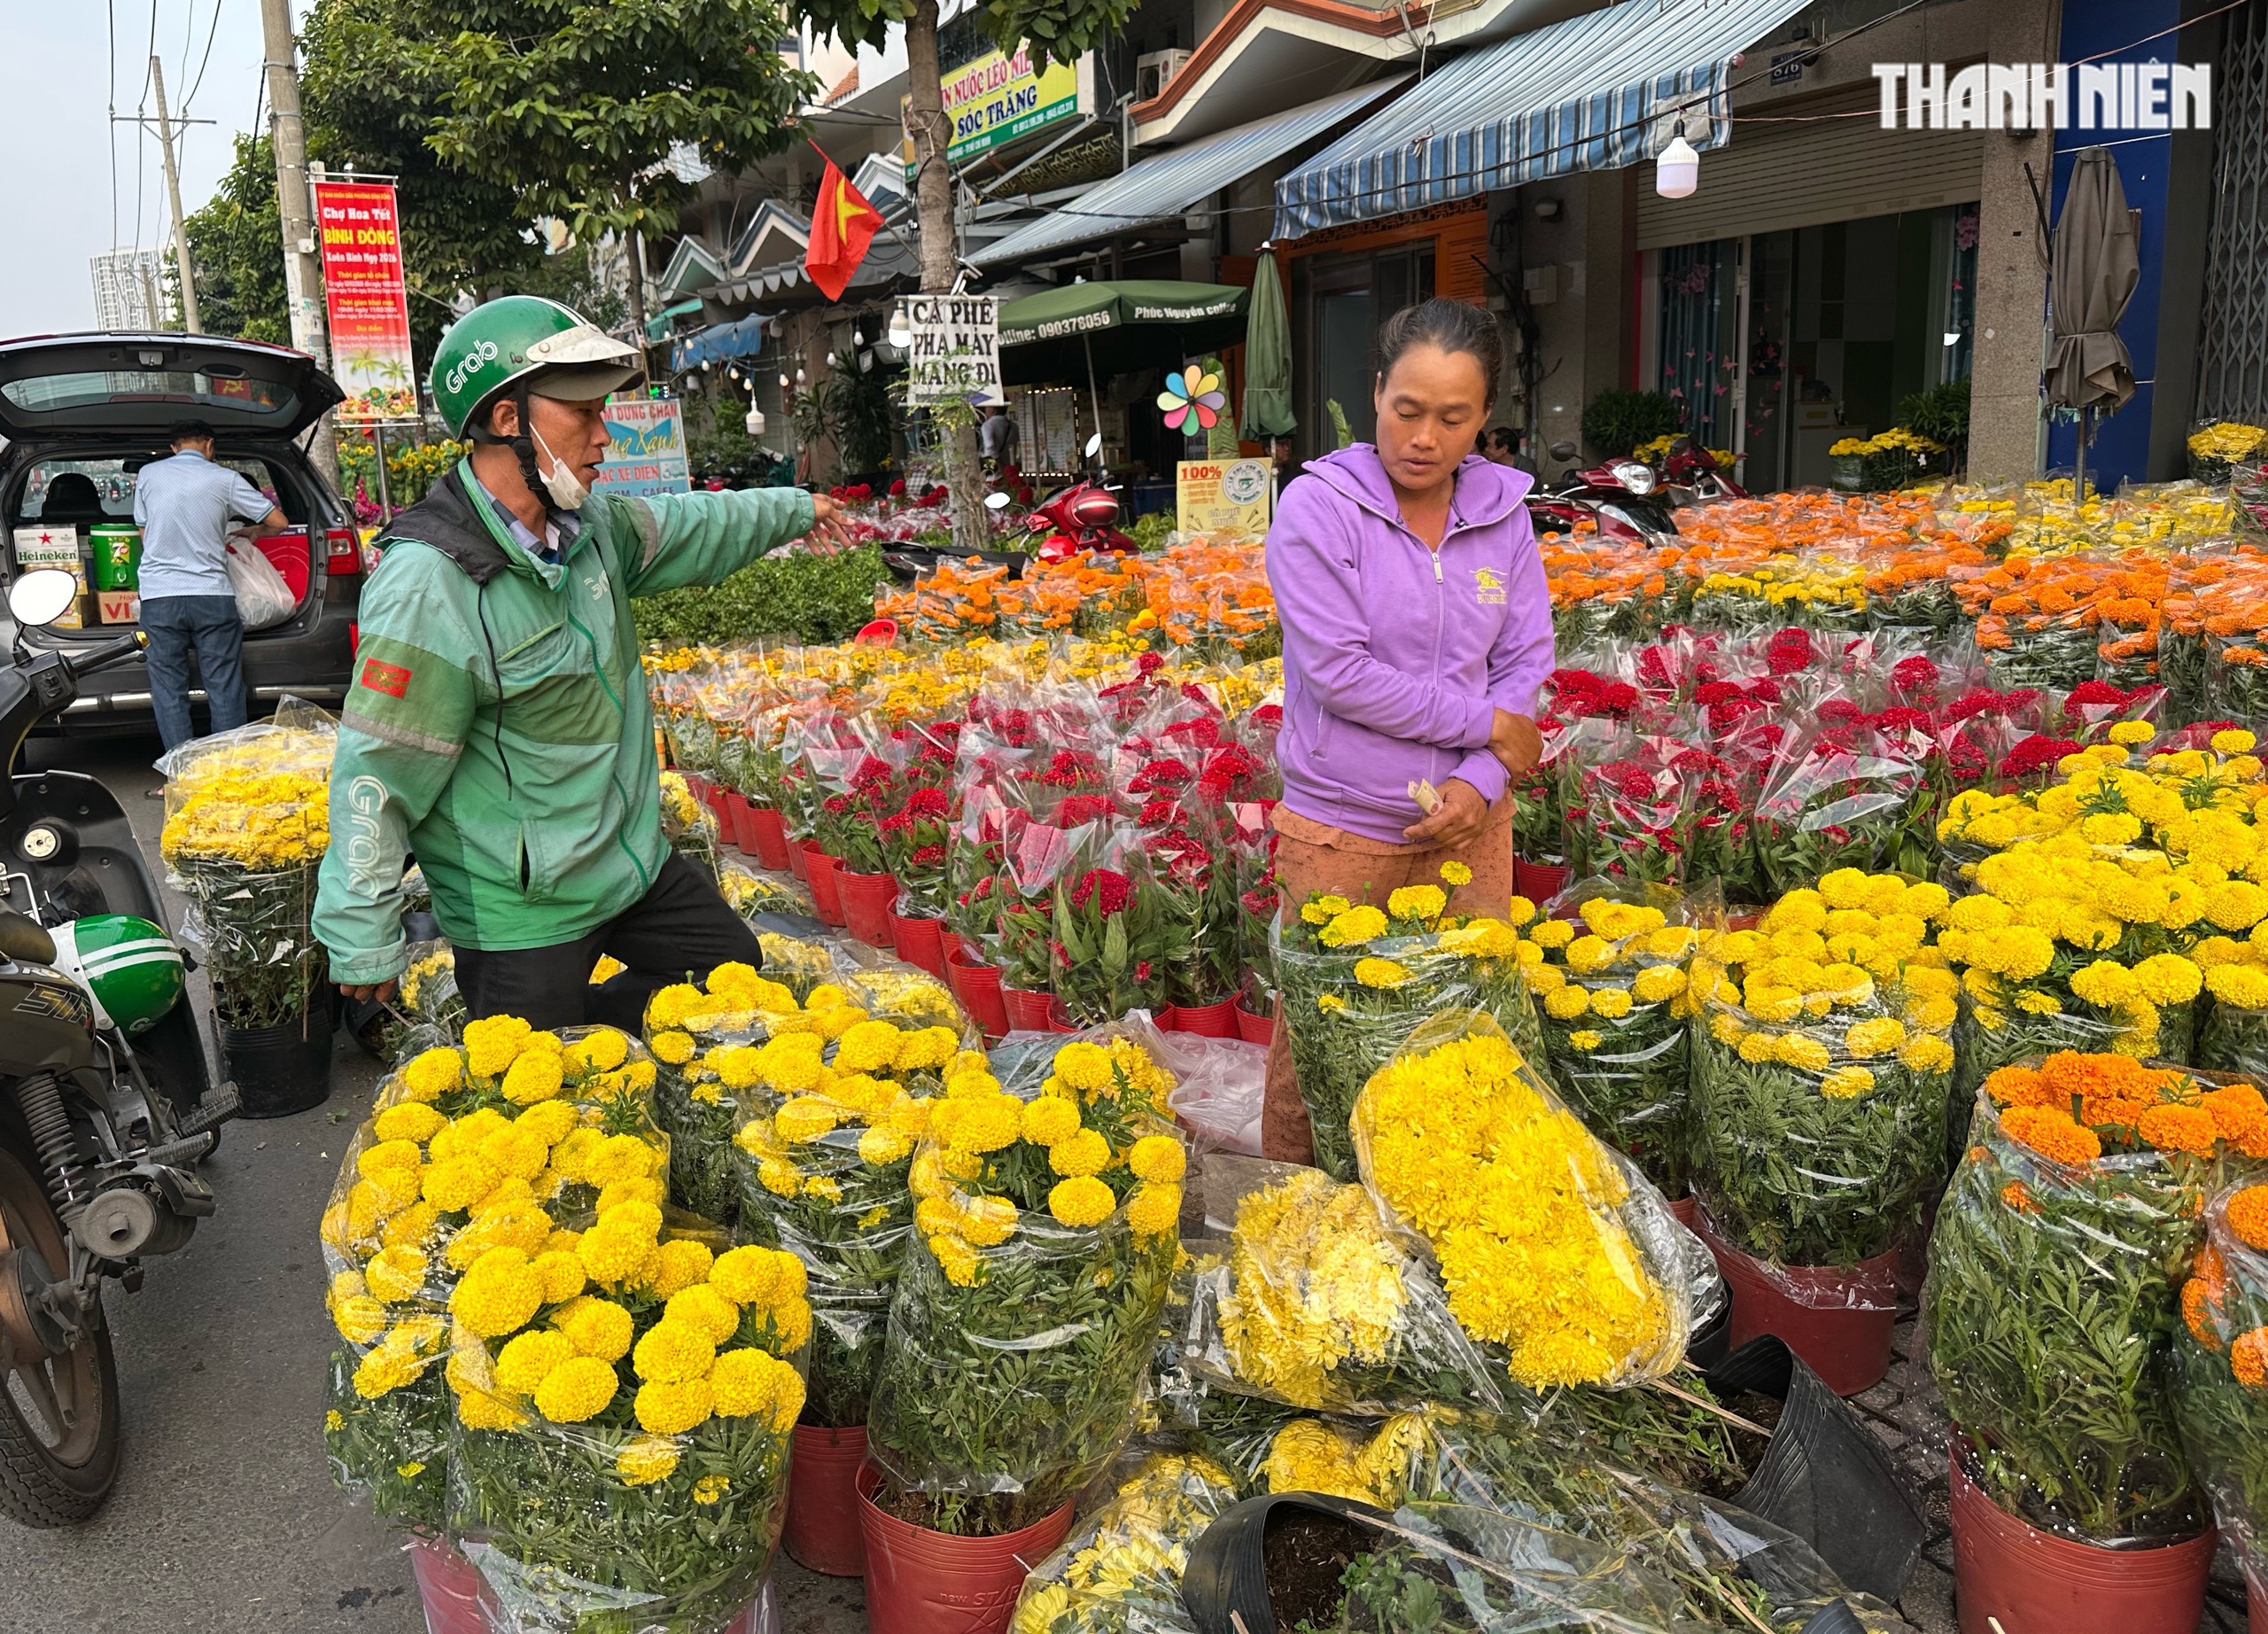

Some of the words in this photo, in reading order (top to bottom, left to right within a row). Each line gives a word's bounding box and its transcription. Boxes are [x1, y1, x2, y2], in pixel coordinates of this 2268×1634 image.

[958, 108, 983, 137] SÓC
[986, 85, 1037, 125] TRĂNG
[323, 206, 346, 222] Chợ
[347, 207, 369, 220] Hoa
[371, 207, 391, 221] Tết
[323, 226, 353, 245] BÌNH
[357, 226, 395, 245] ĐÔNG
[951, 297, 993, 325] PHÊ
[913, 333, 950, 355] PHA
[998, 329, 1037, 346] otline:
[446, 339, 498, 394] Grab
[913, 362, 971, 385] MANG
[976, 362, 997, 385] ĐI
[635, 426, 680, 457] Xanh
[617, 466, 633, 481] XE
[1182, 466, 1222, 479] 100%
[18, 551, 77, 562] Heineken
[348, 775, 392, 899] Grab
